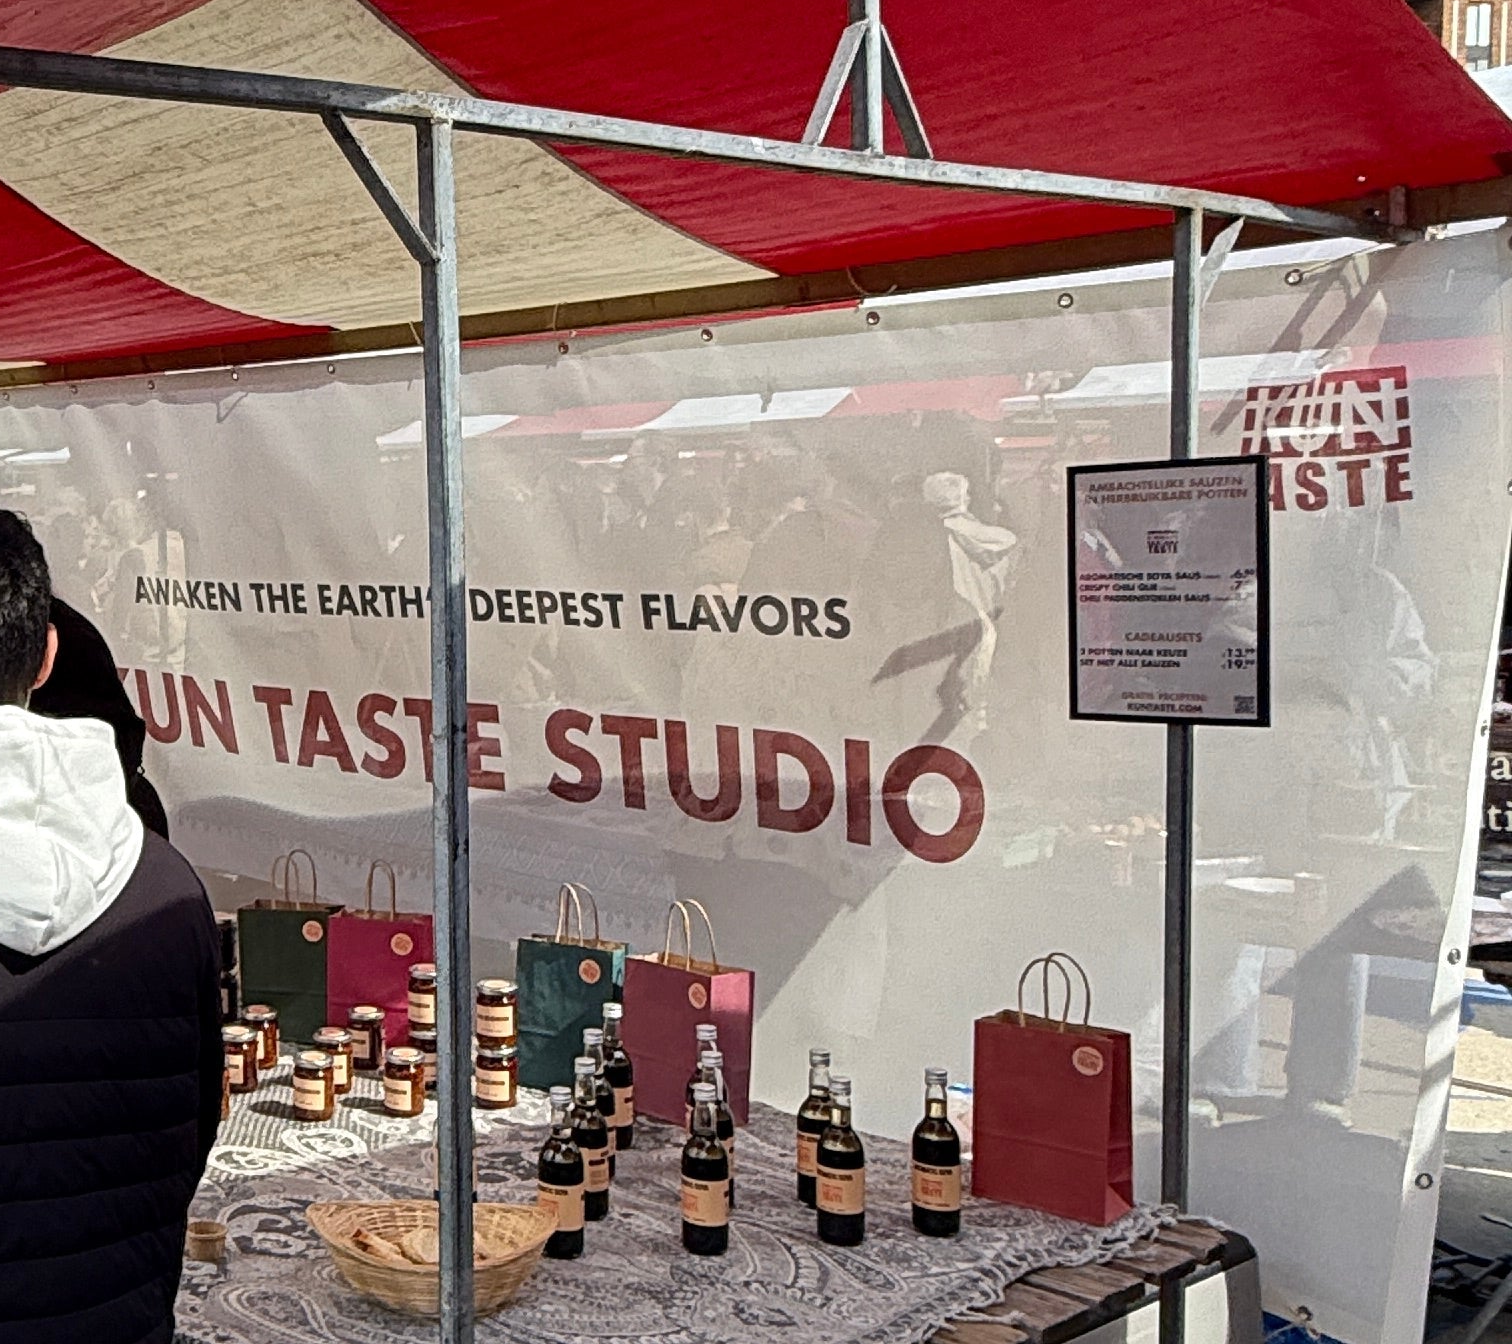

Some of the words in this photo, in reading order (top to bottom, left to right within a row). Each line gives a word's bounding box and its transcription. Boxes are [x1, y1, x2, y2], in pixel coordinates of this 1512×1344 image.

[134, 575, 243, 613] AWAKEN
[249, 582, 308, 614] THE
[468, 588, 624, 630] DEEPEST
[640, 593, 852, 640] FLAVORS
[117, 666, 240, 755] UN
[544, 708, 985, 864] STUDIO
